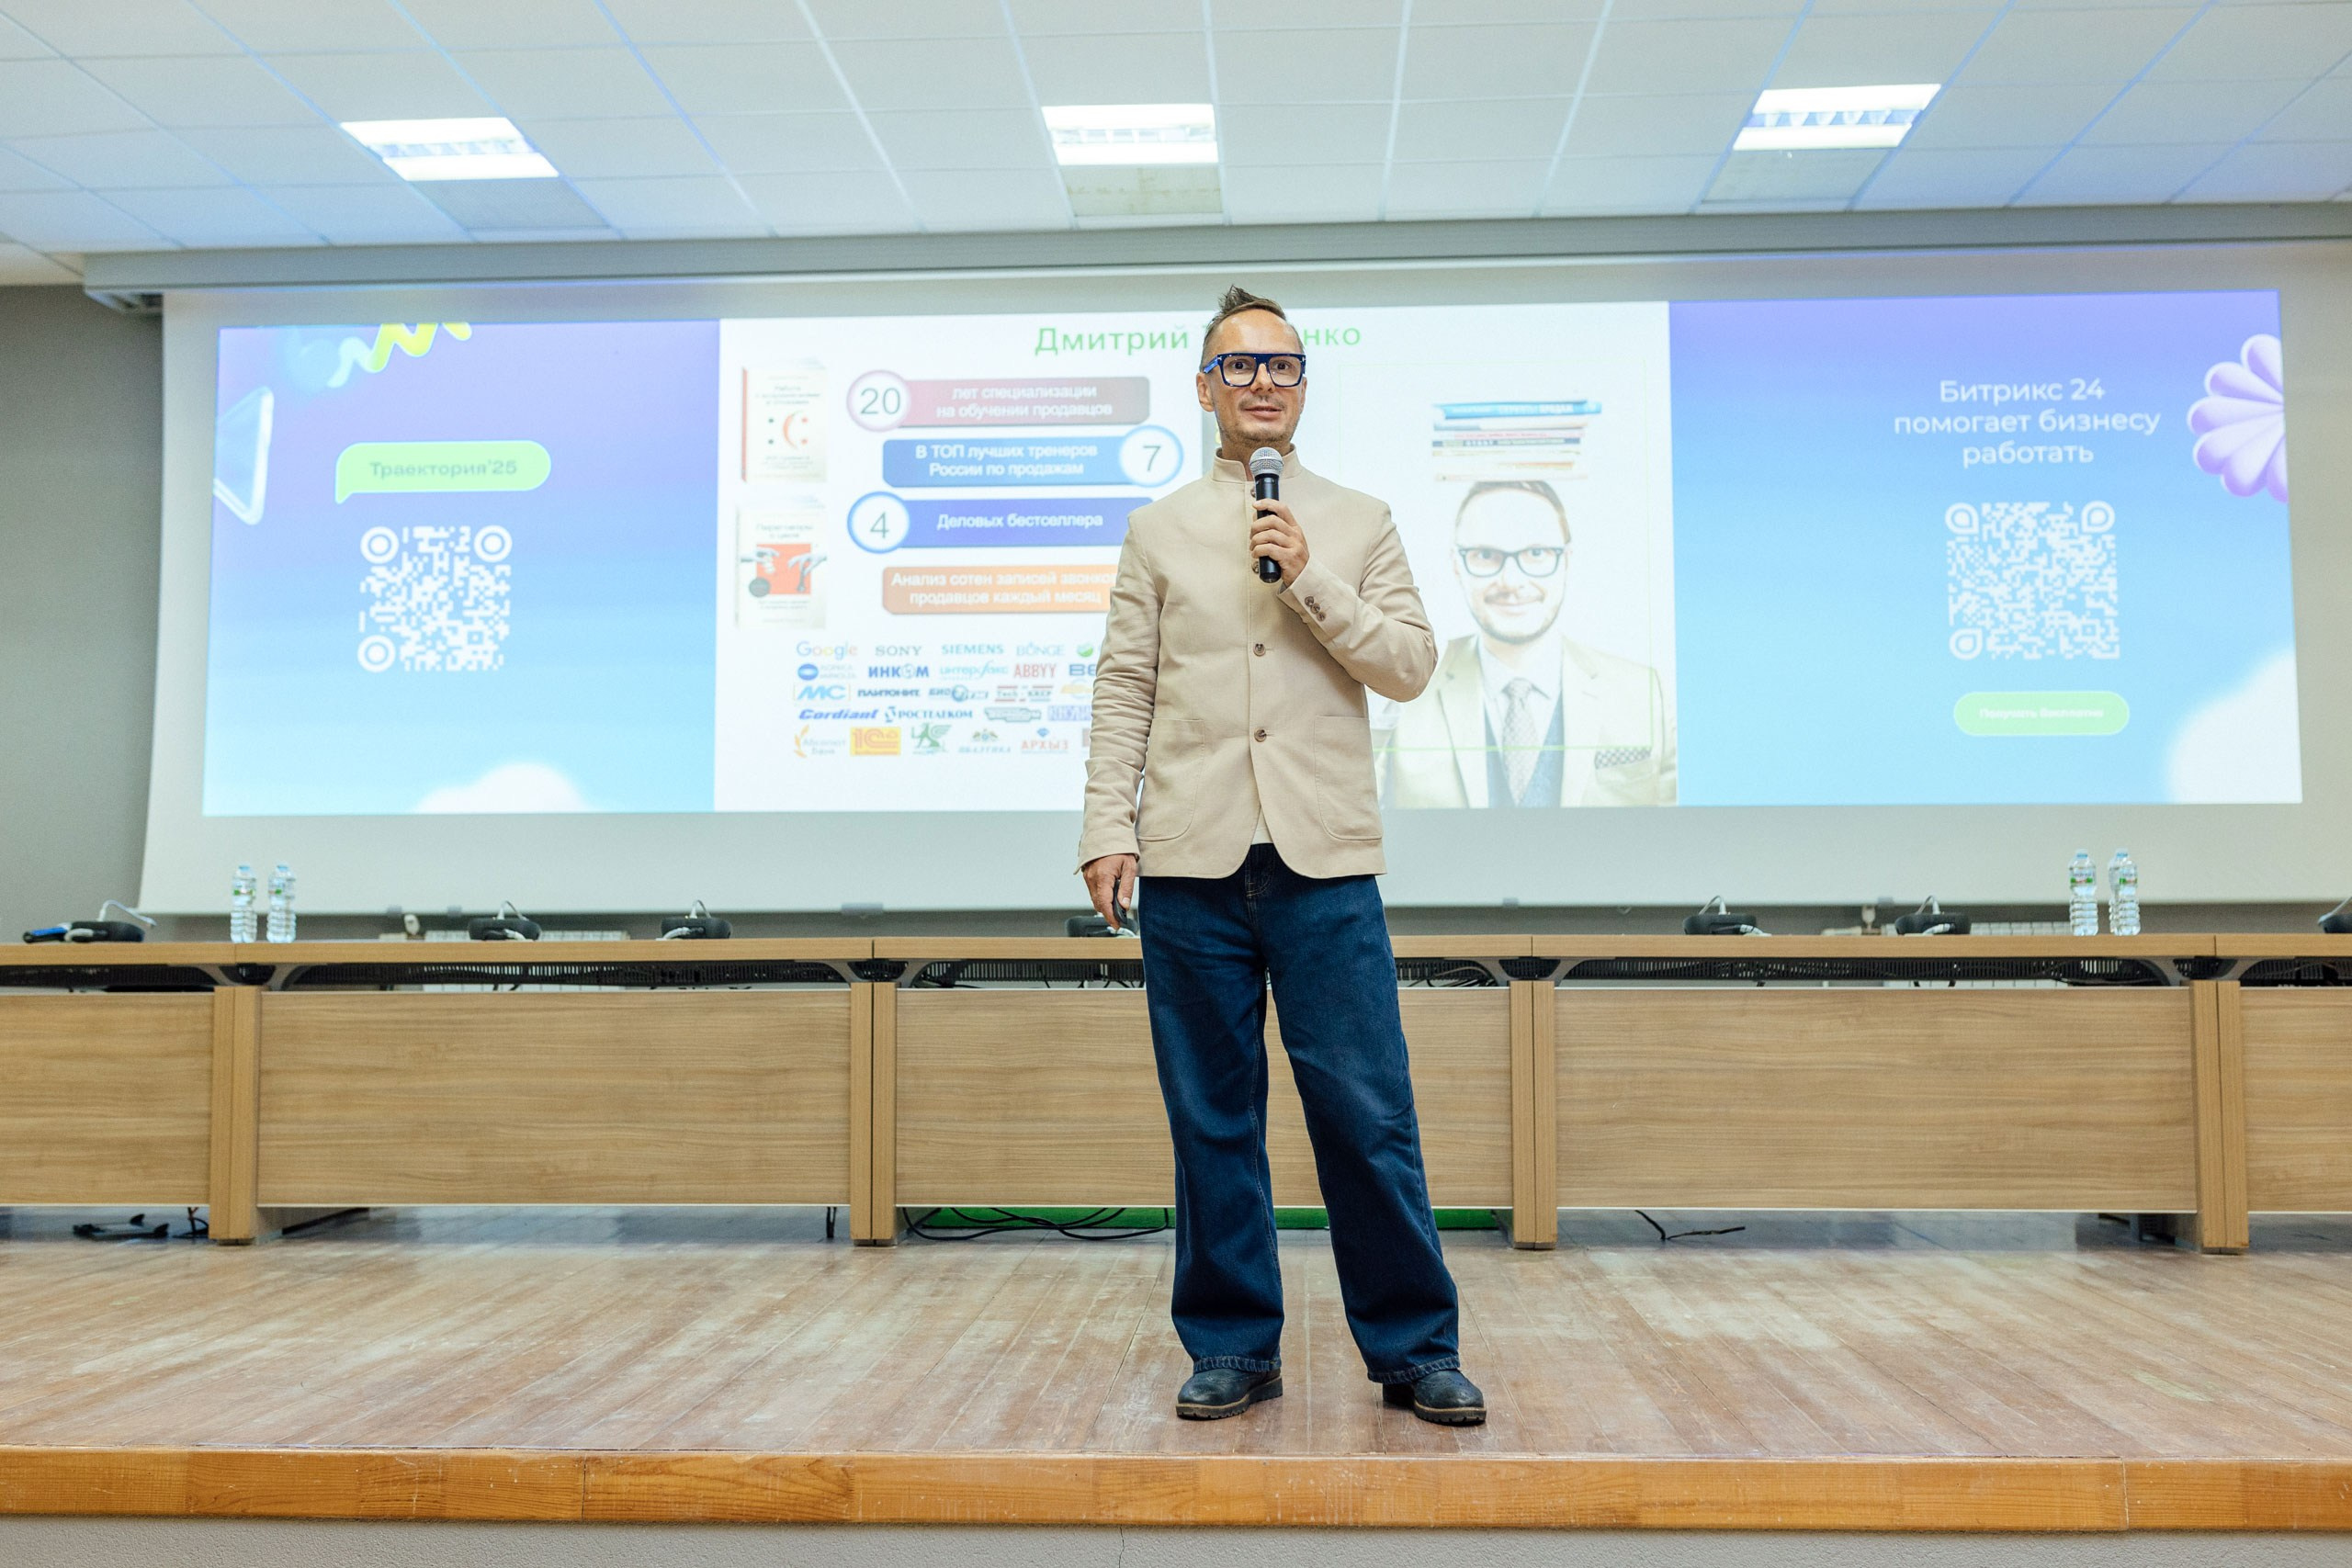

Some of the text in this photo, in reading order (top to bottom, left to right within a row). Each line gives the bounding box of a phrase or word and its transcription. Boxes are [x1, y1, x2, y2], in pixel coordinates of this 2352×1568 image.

[1035, 324, 1188, 355] Дмитрий
[859, 387, 901, 415] 20
[952, 385, 1098, 401] лет специализации
[1939, 378, 2106, 406] Битрикс 24
[936, 403, 1114, 422] на обучении продавцов
[1894, 408, 2162, 436] помогает бизнесу
[915, 445, 1098, 462] В ТОП лучших тренеров
[1142, 445, 1161, 472] 7
[1962, 439, 2095, 469] работать
[929, 463, 1084, 478] России по продажам
[869, 511, 890, 540] 4
[937, 512, 1103, 530] Деловых бестселлера
[891, 572, 946, 587] Анализ
[949, 574, 993, 587] сотен
[796, 640, 858, 660] Google
[875, 645, 922, 657] SONY
[941, 644, 1004, 655] SIEMENS
[1013, 663, 1057, 678] ABBYY
[798, 709, 879, 720] Cordiant
